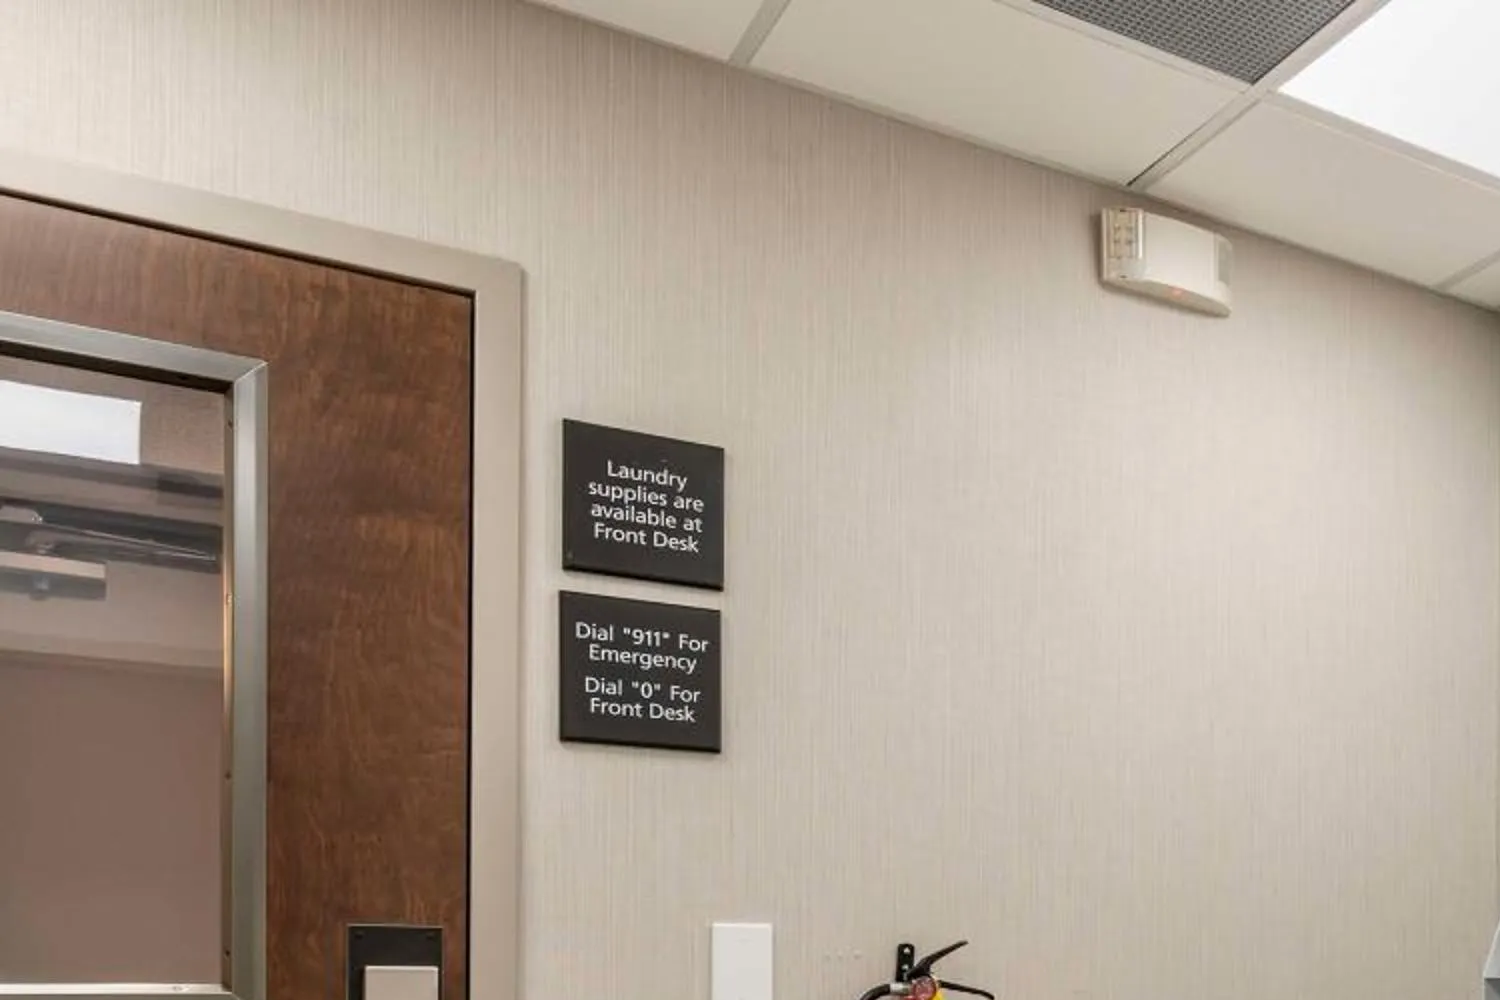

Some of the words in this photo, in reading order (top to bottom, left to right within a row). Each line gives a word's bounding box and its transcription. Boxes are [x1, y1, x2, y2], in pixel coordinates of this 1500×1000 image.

[607, 459, 688, 493] Laundry
[588, 481, 668, 507] supplies
[673, 495, 704, 513] are
[591, 503, 677, 529] available
[683, 518, 703, 533] at
[594, 521, 647, 545] Front
[653, 530, 699, 553] Desk
[575, 621, 614, 642] Dial
[622, 627, 670, 647] "911"
[678, 633, 709, 652] For
[589, 643, 697, 675] Emergency
[584, 676, 623, 696] Dial
[631, 680, 662, 699] "0"
[669, 685, 701, 703] For
[590, 697, 643, 718] Front
[649, 703, 696, 723] Desk
